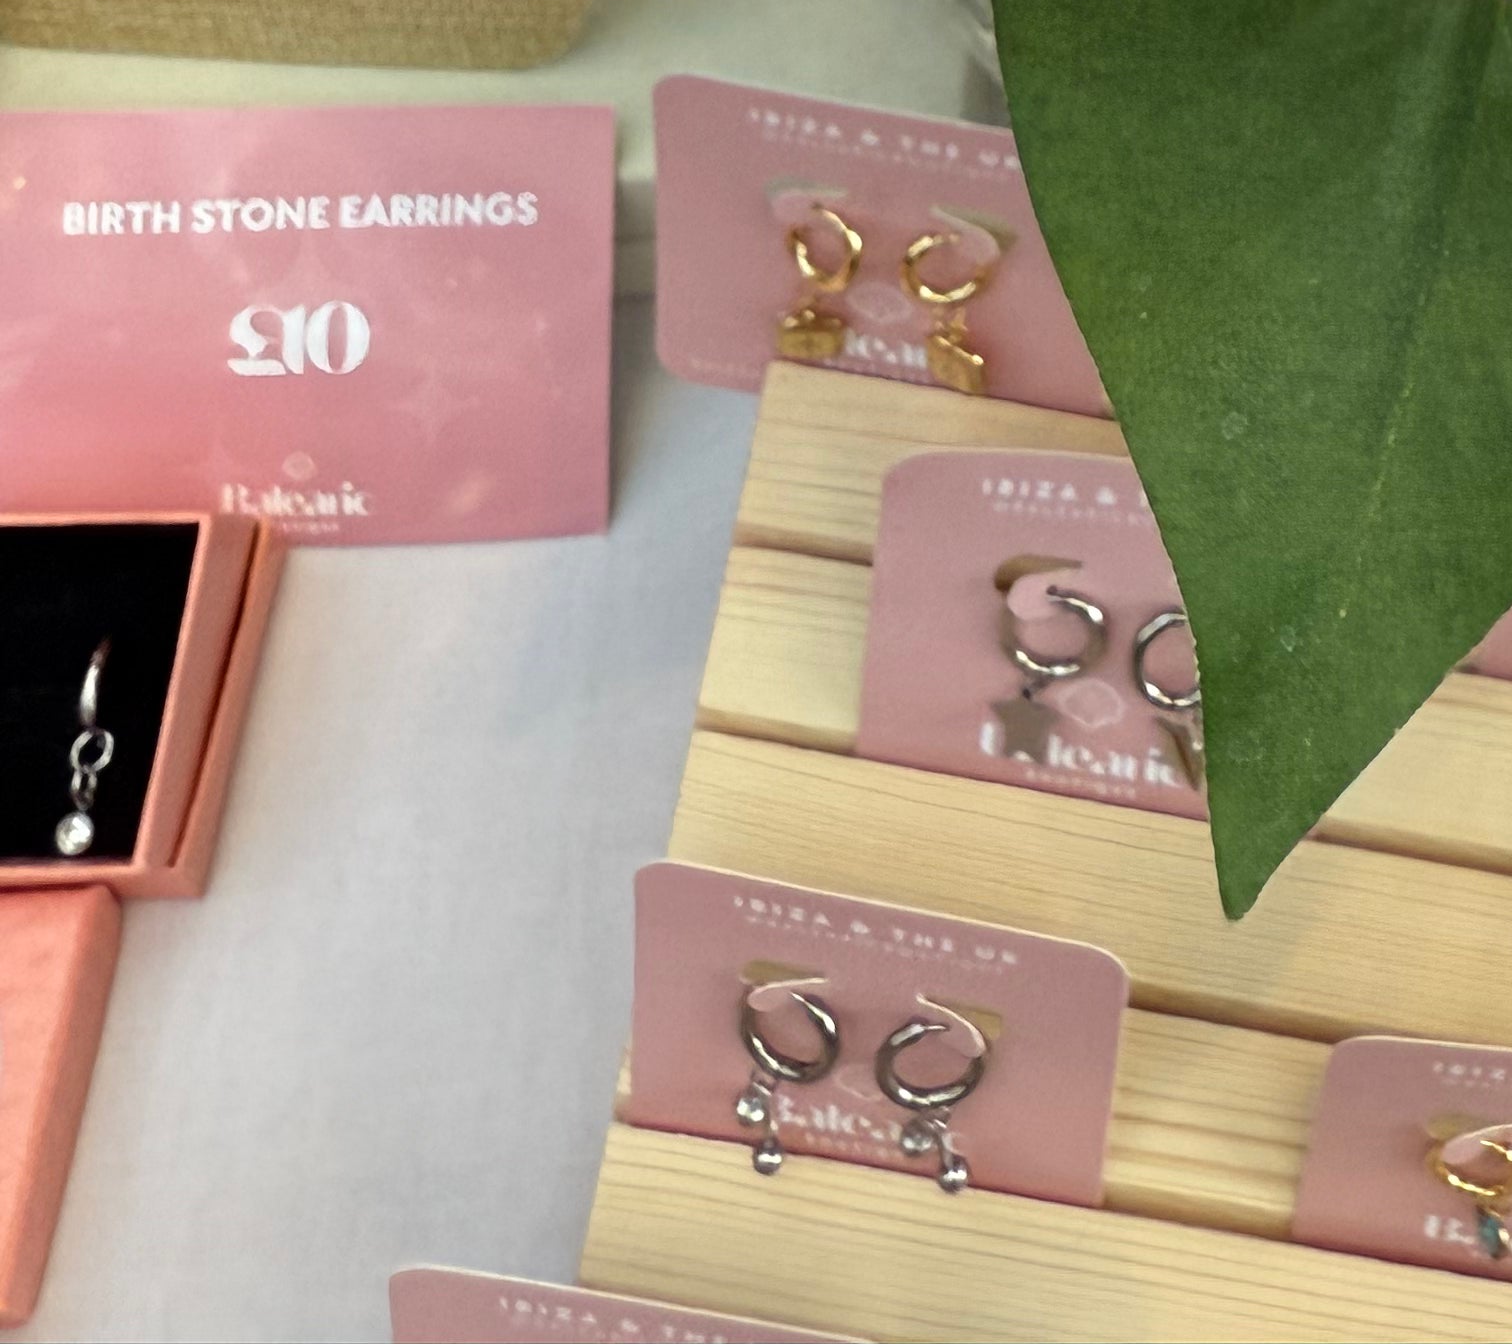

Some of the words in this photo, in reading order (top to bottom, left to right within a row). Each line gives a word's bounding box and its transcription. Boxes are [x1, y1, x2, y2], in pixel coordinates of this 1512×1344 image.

[62, 201, 180, 235] BIRTH
[190, 195, 330, 233] STONE
[339, 191, 539, 229] EARRINGS
[227, 299, 370, 376] £10
